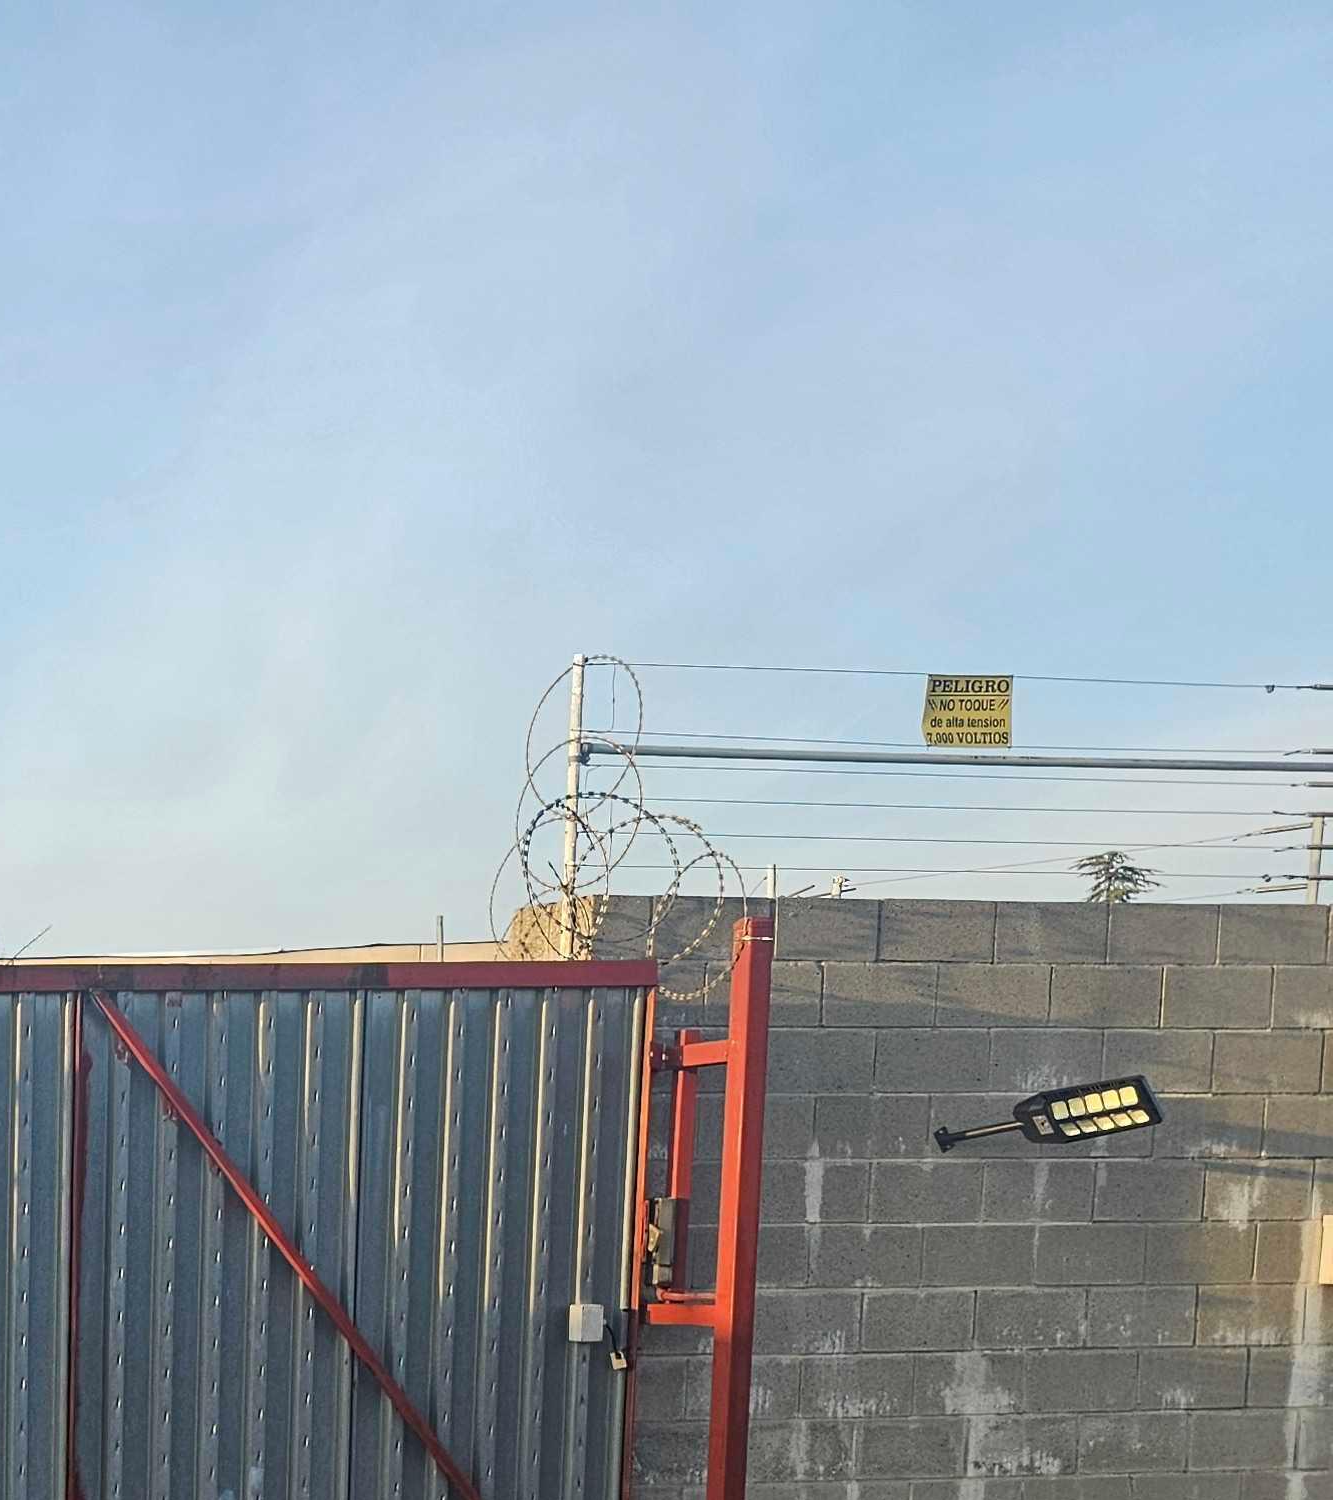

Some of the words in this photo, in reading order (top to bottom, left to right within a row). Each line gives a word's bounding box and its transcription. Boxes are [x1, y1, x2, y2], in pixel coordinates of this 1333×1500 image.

[930, 680, 1010, 693] PELIGRO
[939, 699, 955, 712] NO
[959, 699, 996, 712] TOQUE
[930, 716, 943, 728] de
[946, 716, 964, 728] alta
[967, 716, 1006, 729] tension
[926, 732, 954, 745] 7,000
[956, 732, 1009, 745] VOLTIOS
